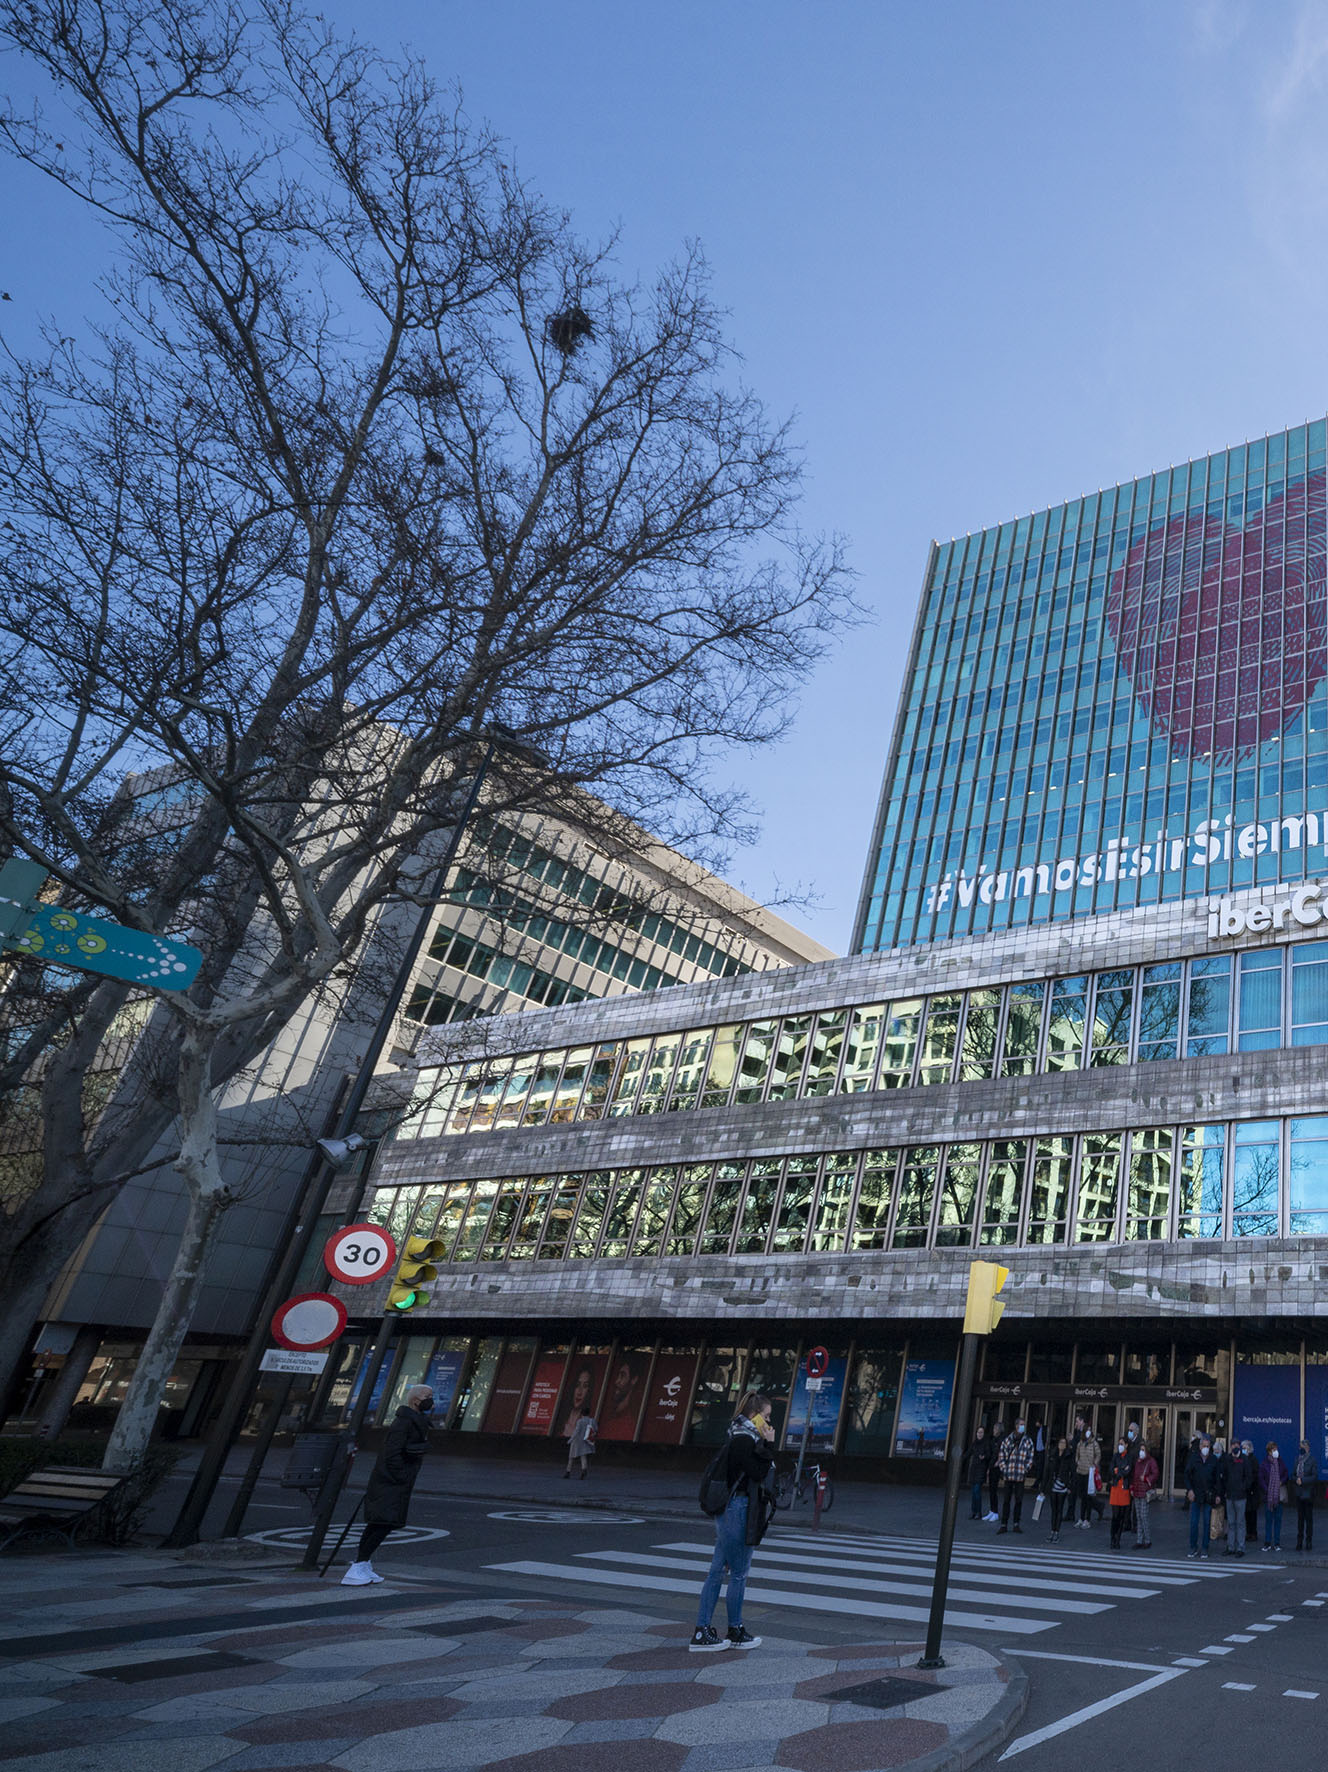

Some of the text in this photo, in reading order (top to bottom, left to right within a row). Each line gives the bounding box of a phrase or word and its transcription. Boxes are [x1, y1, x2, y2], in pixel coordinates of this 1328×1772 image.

[343, 1244, 381, 1266] 30
[1075, 1388, 1097, 1396] iberCaja
[1166, 1390, 1189, 1398] iberCaja
